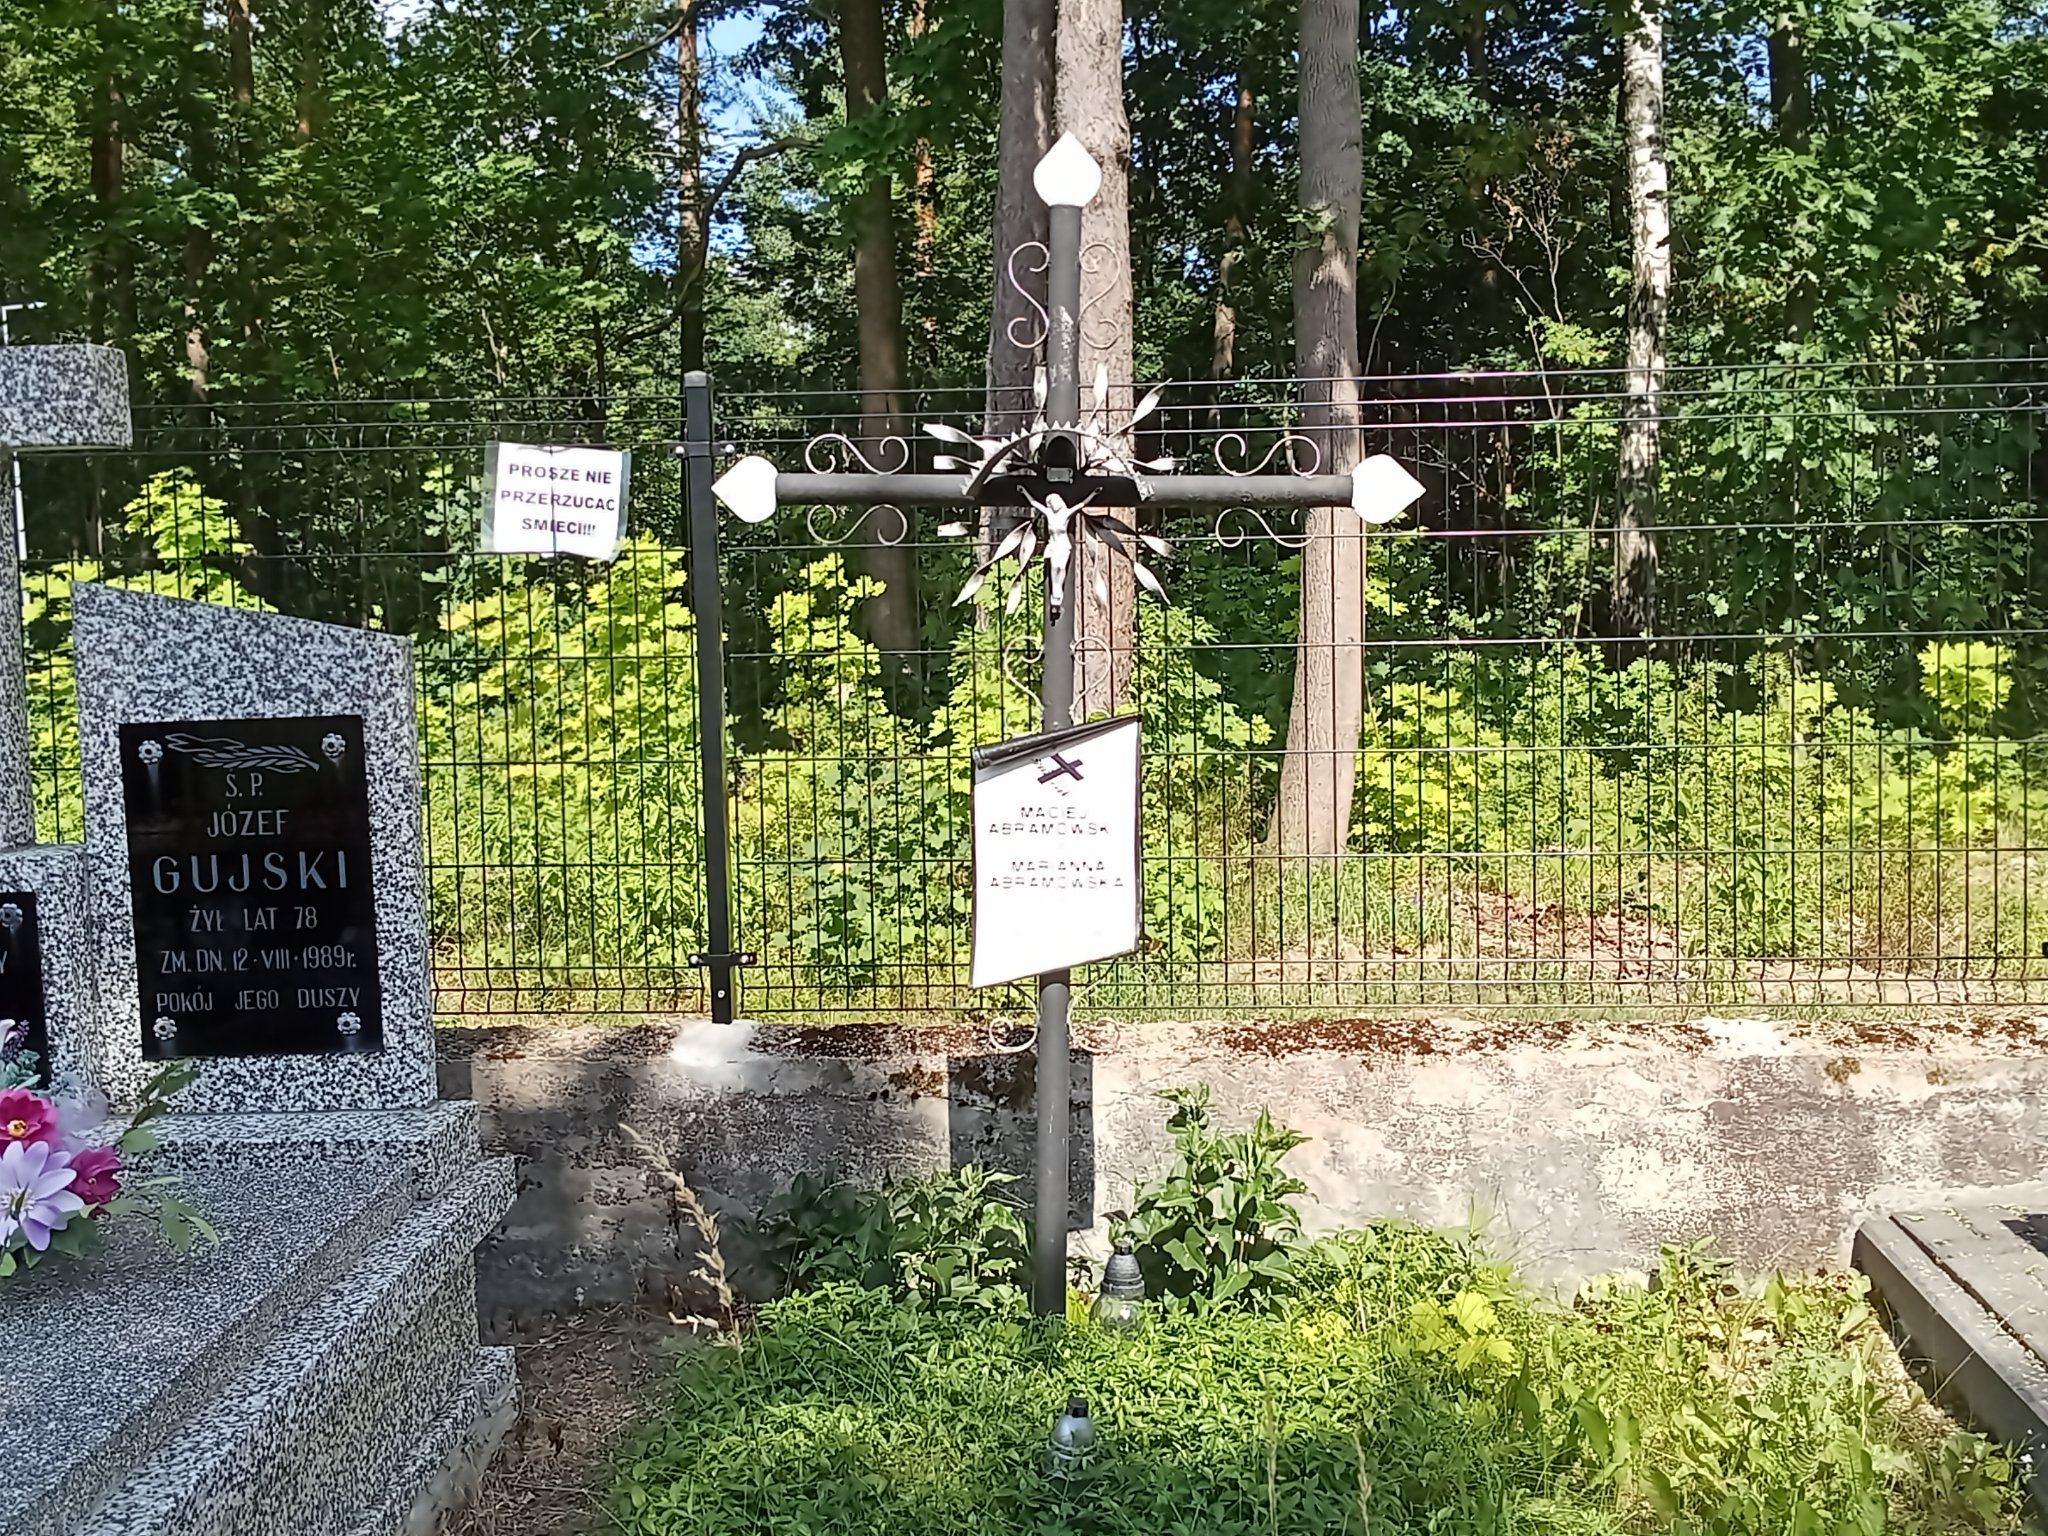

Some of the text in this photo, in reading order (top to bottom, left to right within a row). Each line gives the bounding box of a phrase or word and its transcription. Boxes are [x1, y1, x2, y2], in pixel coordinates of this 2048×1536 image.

[509, 463, 612, 484] PROSZE NIE
[501, 490, 615, 511] PRZERZUCAC
[250, 773, 263, 796] P.
[207, 803, 289, 837] JÓZEF
[1021, 806, 1088, 820] MACEJ
[989, 822, 1111, 835] ABRAMOWSK
[152, 850, 347, 894] GUJSKI
[1011, 860, 1105, 872] MARANNA
[189, 904, 318, 933] ŻYŁ LAT 78
[156, 985, 361, 1012] POKÓJ JEGO DUSZY
